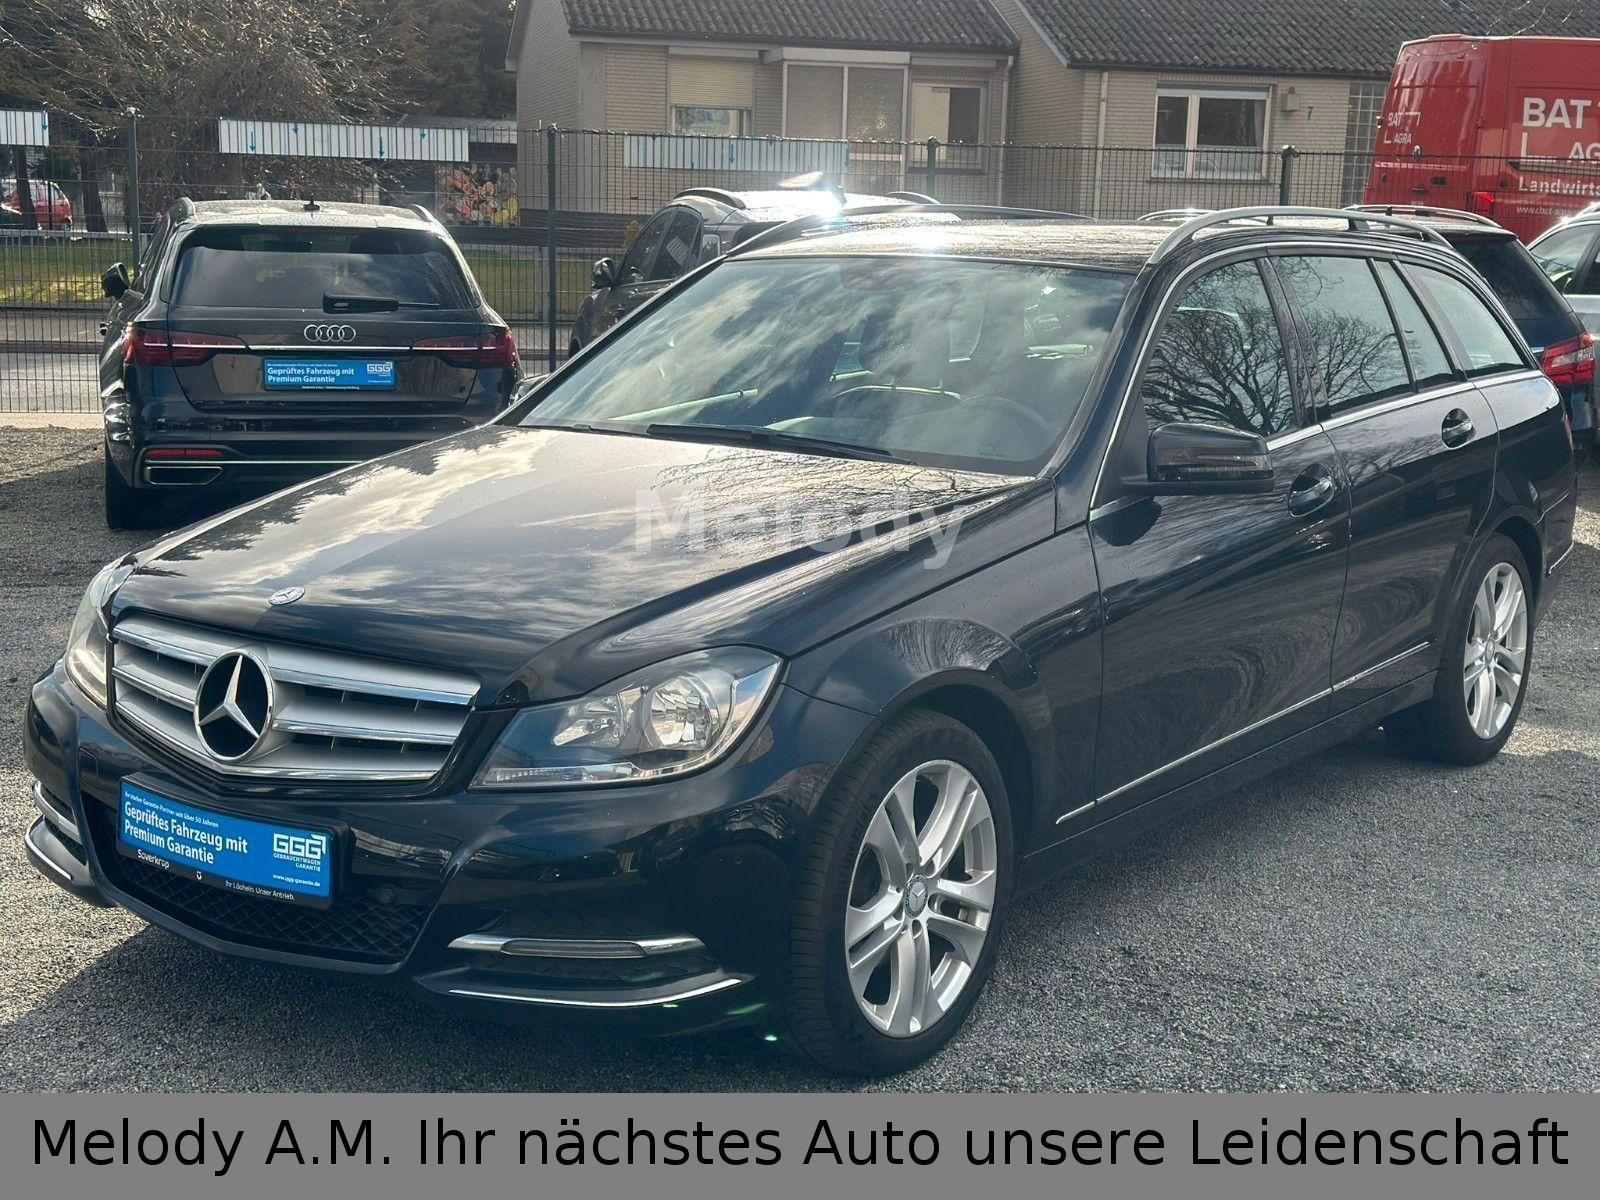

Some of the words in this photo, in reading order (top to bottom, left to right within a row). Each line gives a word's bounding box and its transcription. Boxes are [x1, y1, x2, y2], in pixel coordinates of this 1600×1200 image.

[1307, 105, 1314, 120] 7
[1522, 97, 1592, 129] BAT
[267, 367, 305, 376] Geprüftes
[306, 367, 341, 376] Fahrzeug
[341, 367, 355, 375] mit
[367, 362, 392, 371] GGG
[267, 375, 302, 383] Premium
[302, 375, 336, 383] Garantie
[124, 801, 170, 832] Geprüftes
[170, 818, 223, 852] Fahrzeug
[225, 836, 248, 854] mit
[195, 816, 202, 824] 50
[124, 819, 165, 849] Premium
[166, 836, 214, 865] Garantie
[273, 833, 326, 860] GGG
[295, 862, 321, 873] GARANTIE
[225, 879, 235, 889] Ihr
[255, 886, 272, 898] Unser
[272, 889, 296, 901] Antrieb.
